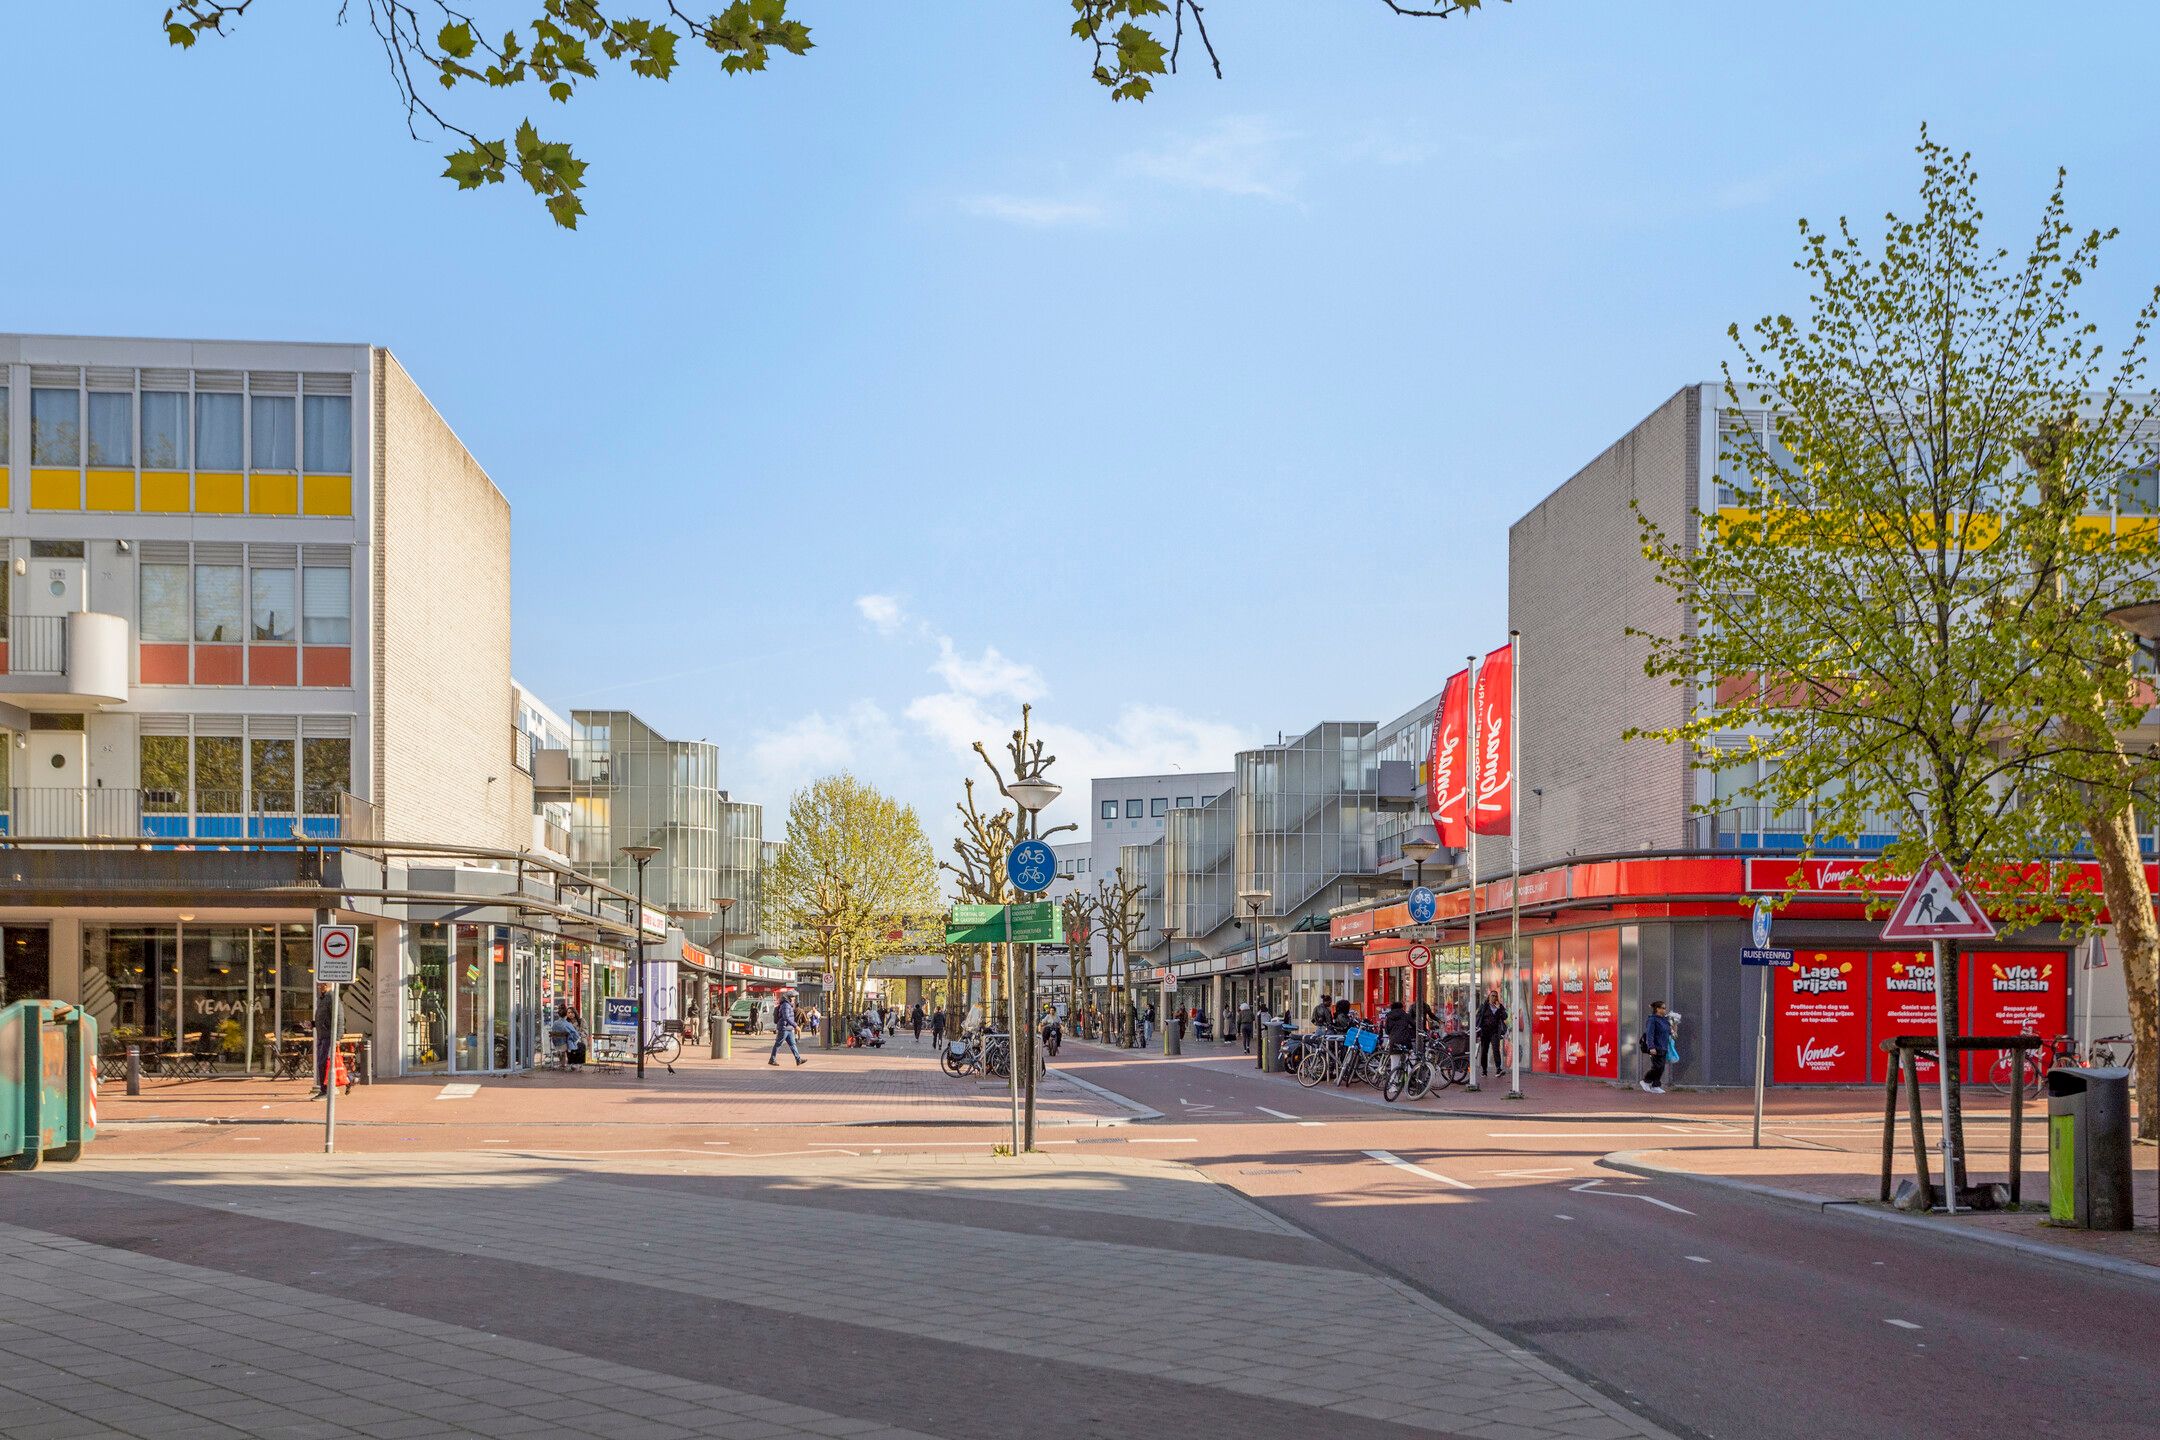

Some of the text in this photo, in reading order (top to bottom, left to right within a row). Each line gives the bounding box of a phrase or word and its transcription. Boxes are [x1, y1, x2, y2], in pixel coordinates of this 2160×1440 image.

[1801, 966, 1840, 979] Lage
[1905, 966, 1935, 978] Top
[2004, 965, 2037, 979] Vlot
[1792, 979, 1848, 994] prijzen
[1886, 977, 1936, 991] kwalit
[1993, 978, 2049, 991] inslaan
[609, 1003, 632, 1013] Lyca
[1797, 1037, 1845, 1069] Vomar
